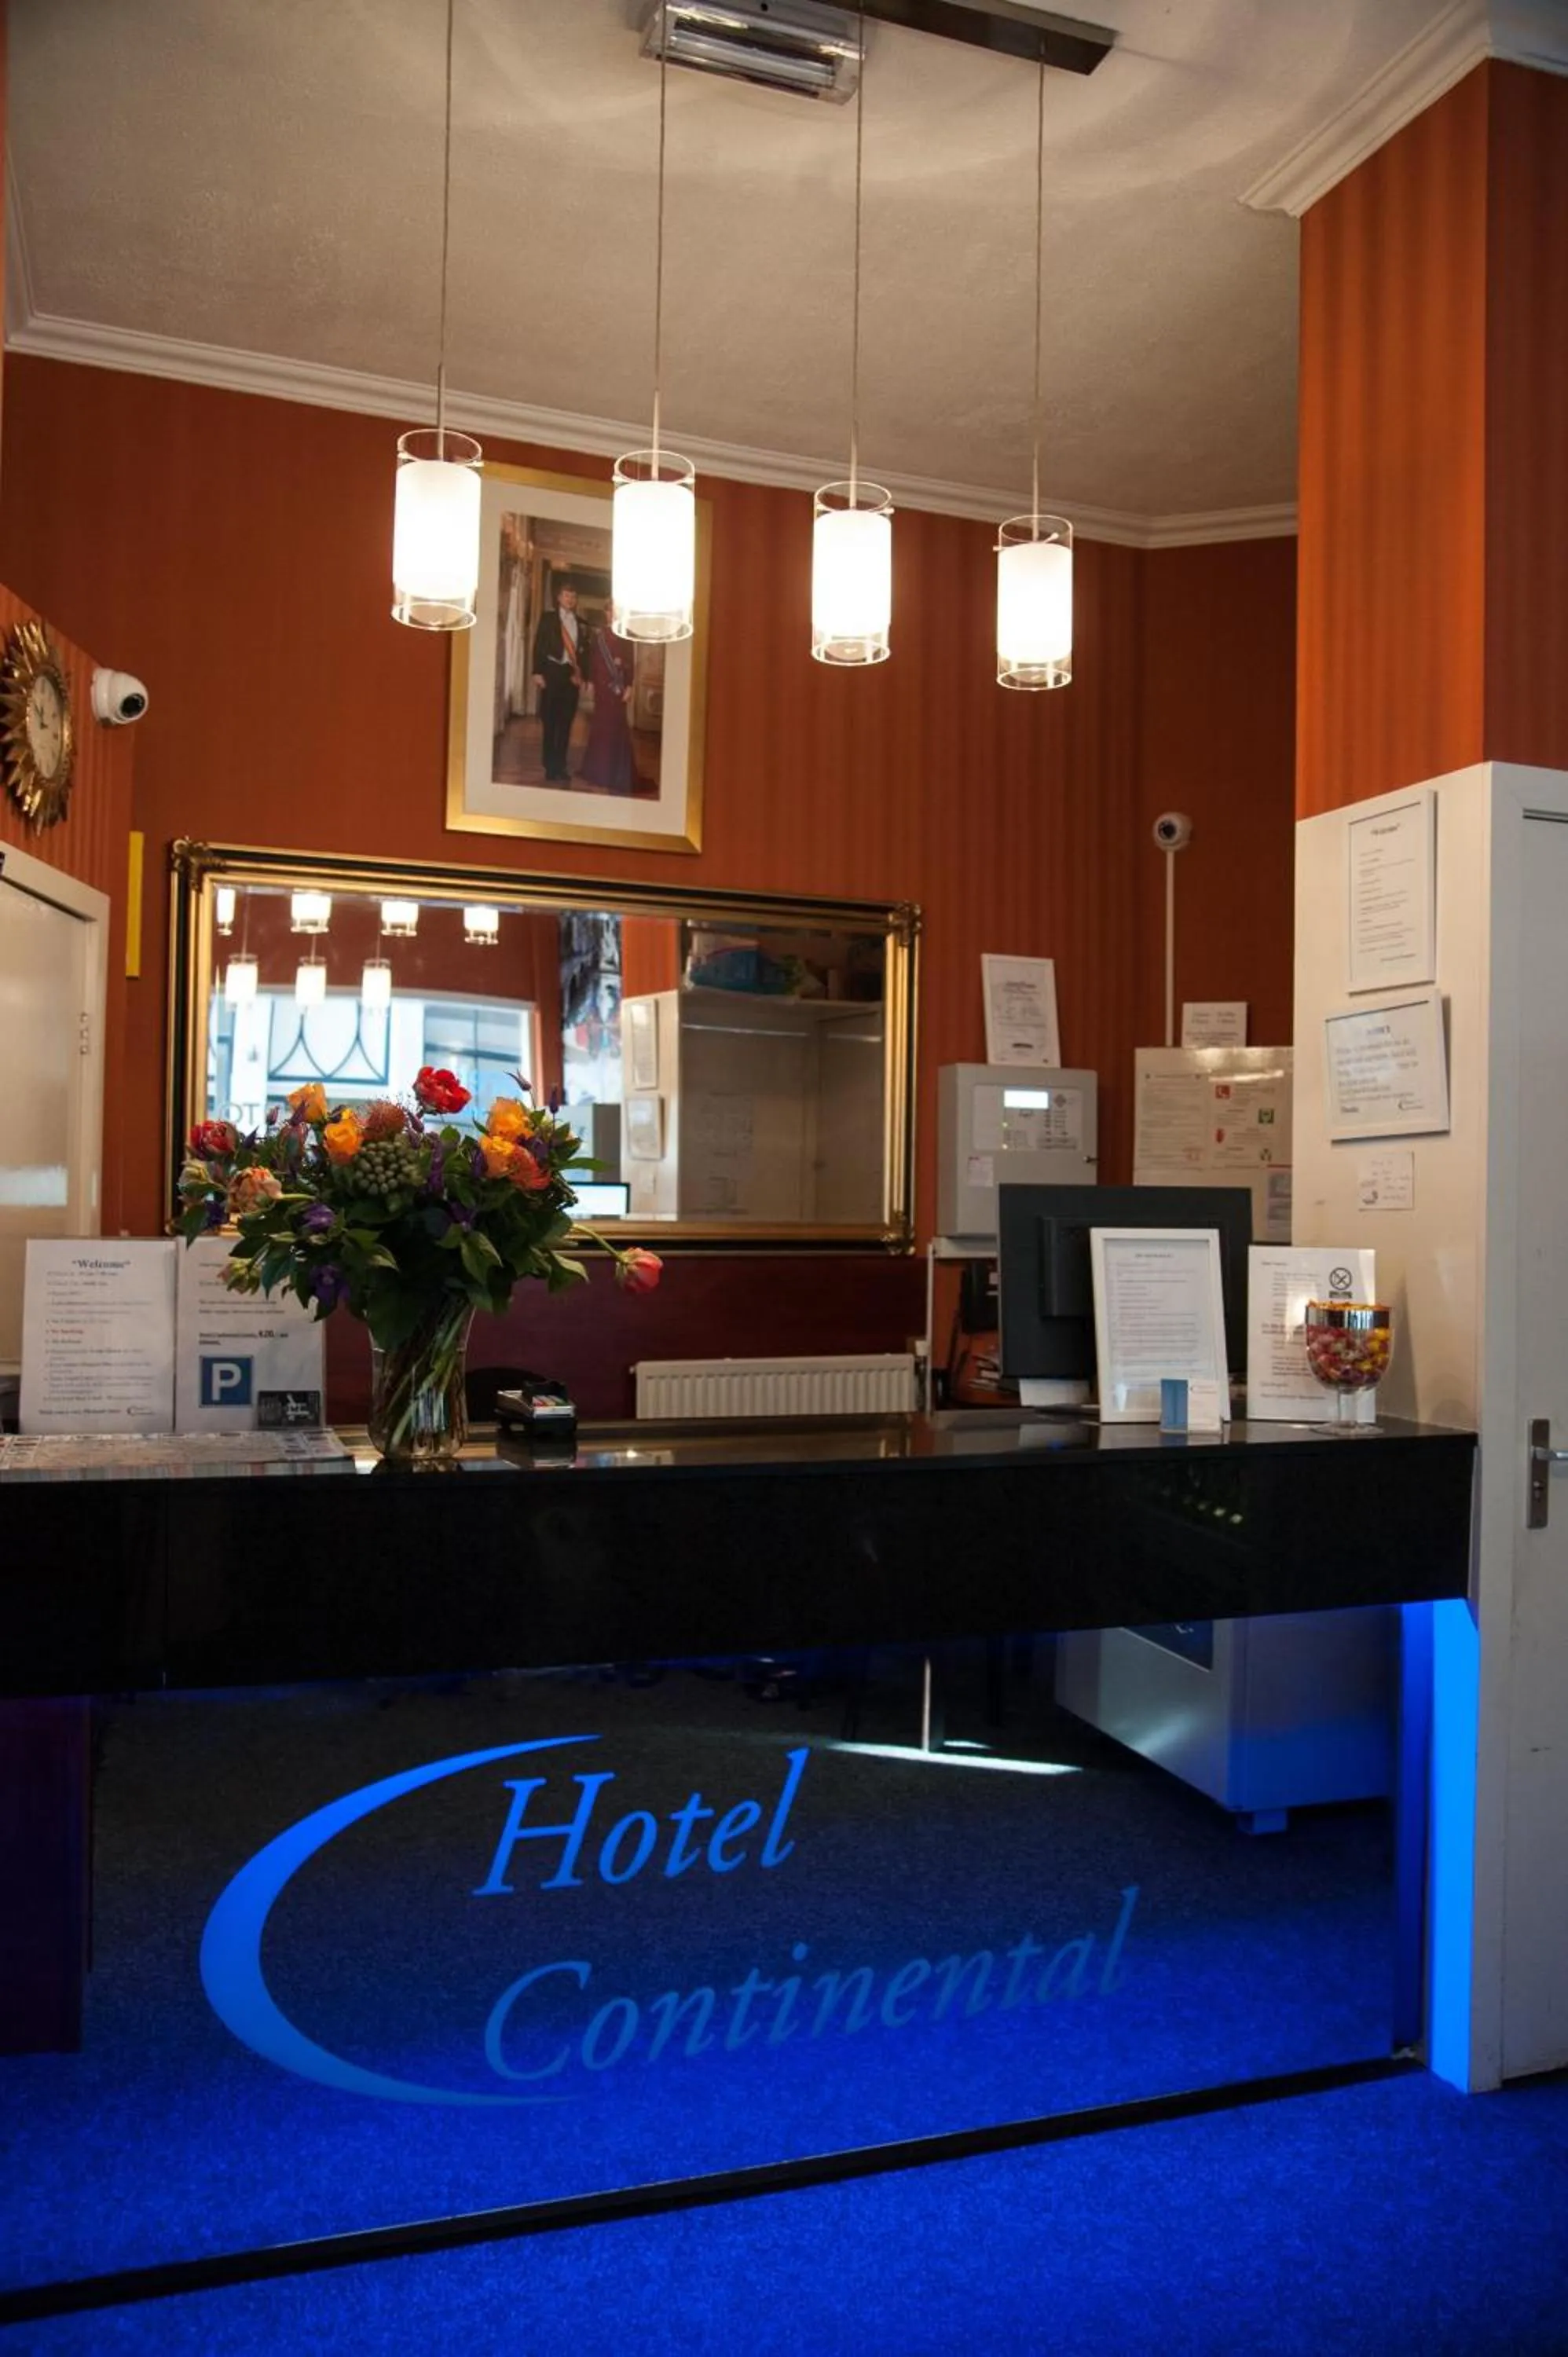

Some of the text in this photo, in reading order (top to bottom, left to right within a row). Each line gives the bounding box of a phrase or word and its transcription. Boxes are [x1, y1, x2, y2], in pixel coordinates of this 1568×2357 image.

[212, 1363, 241, 1401] P
[472, 1747, 810, 1896] Hotel
[484, 1885, 1139, 2082] Continental
